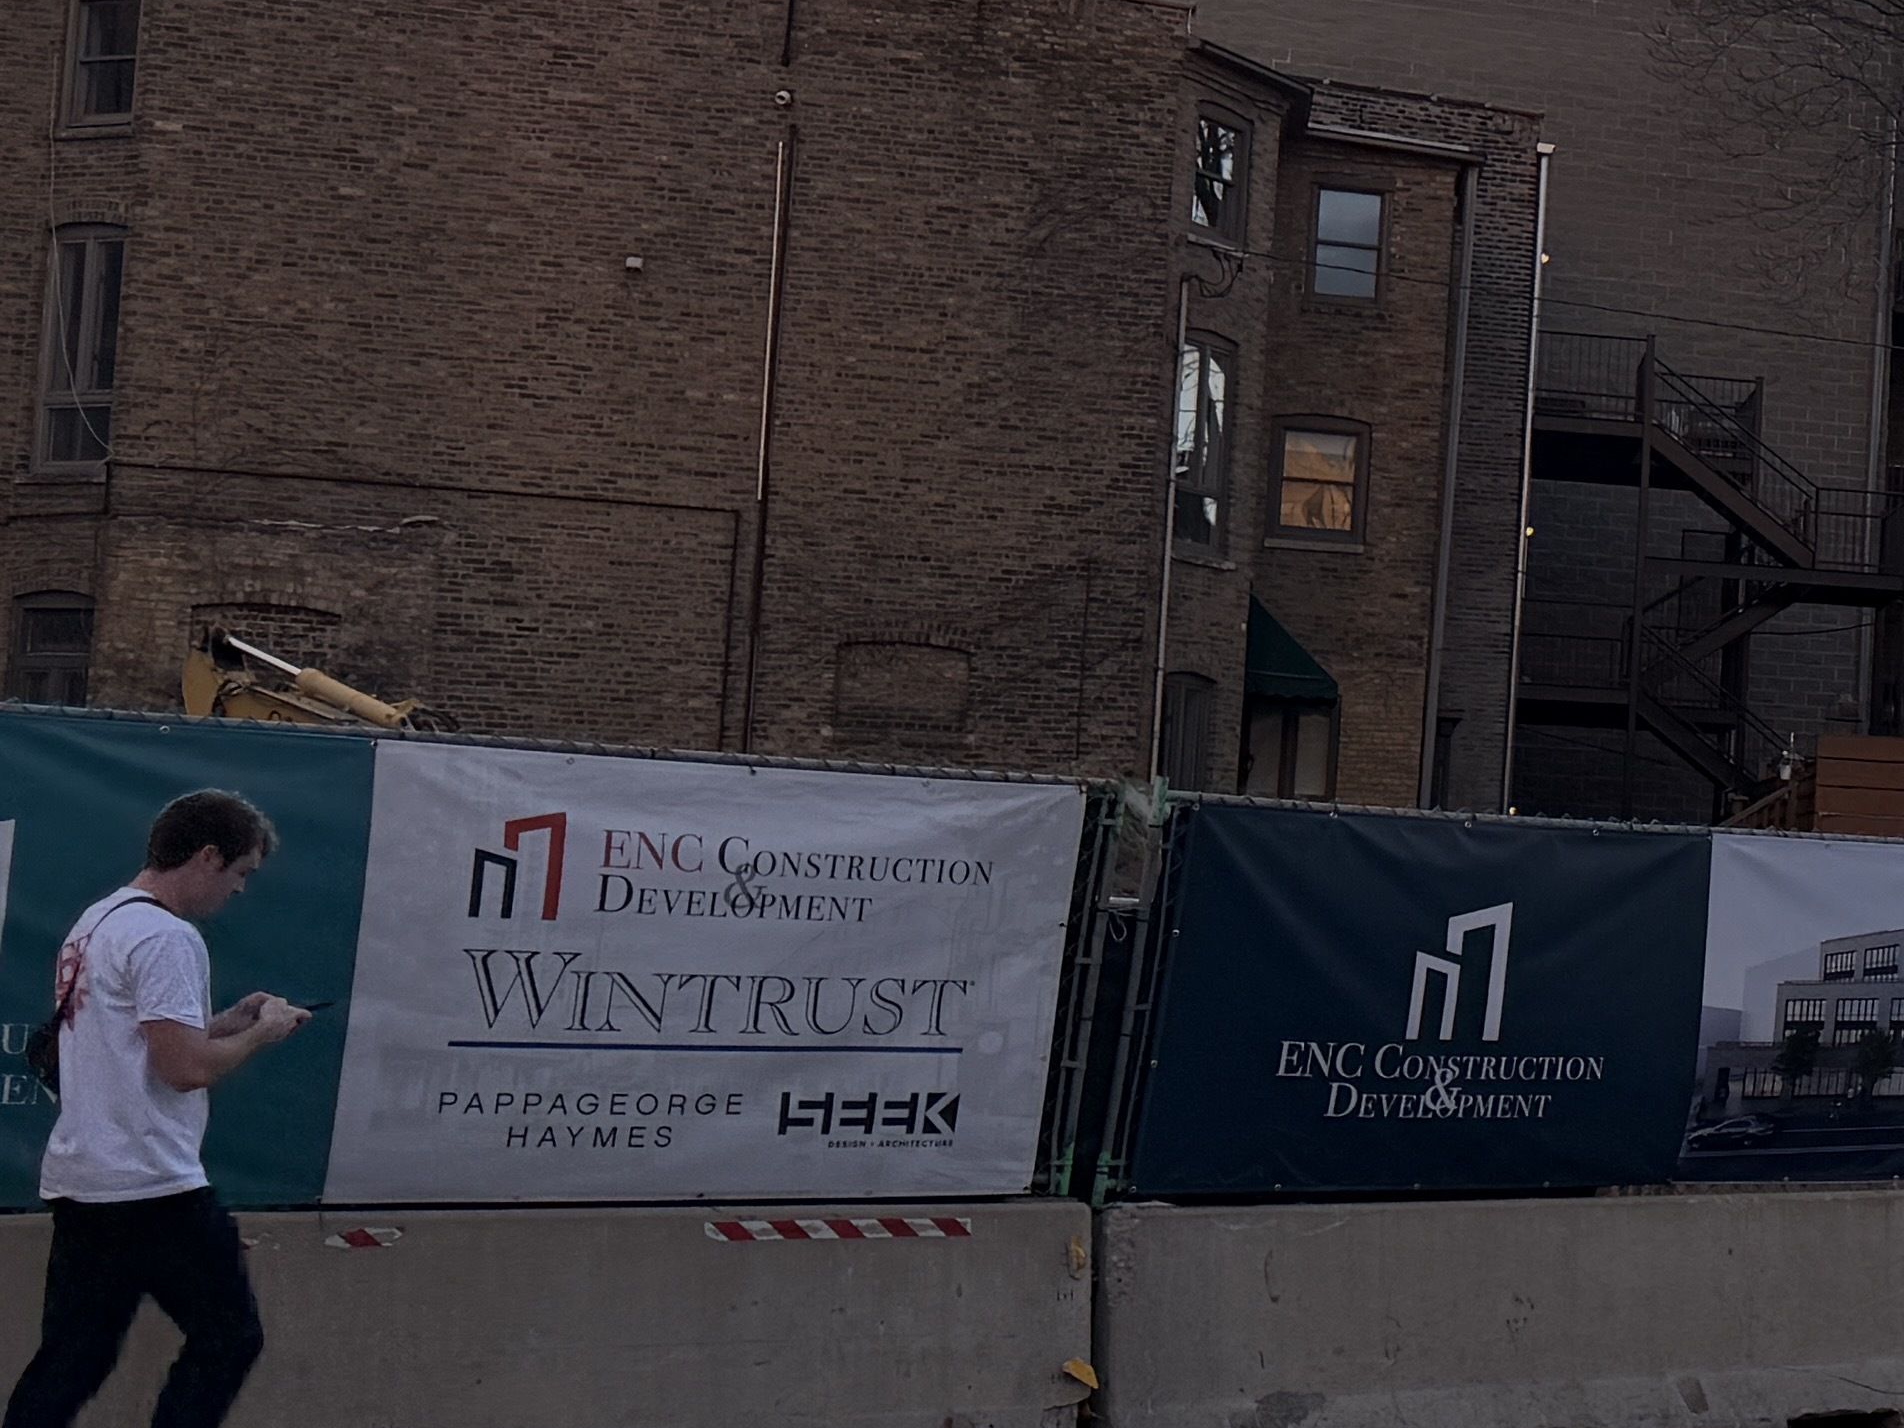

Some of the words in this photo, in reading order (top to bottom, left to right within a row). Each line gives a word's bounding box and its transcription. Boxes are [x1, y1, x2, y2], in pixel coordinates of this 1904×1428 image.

[600, 828, 704, 874] ENC
[462, 948, 970, 1037] WINTRUST
[1275, 1039, 1366, 1079] ENC
[437, 1091, 744, 1118] PAPPAGEORGE
[505, 1125, 675, 1149] HAYMES
[827, 1139, 867, 1149] DESIGN
[877, 1139, 954, 1149] ARCHITECTURE
